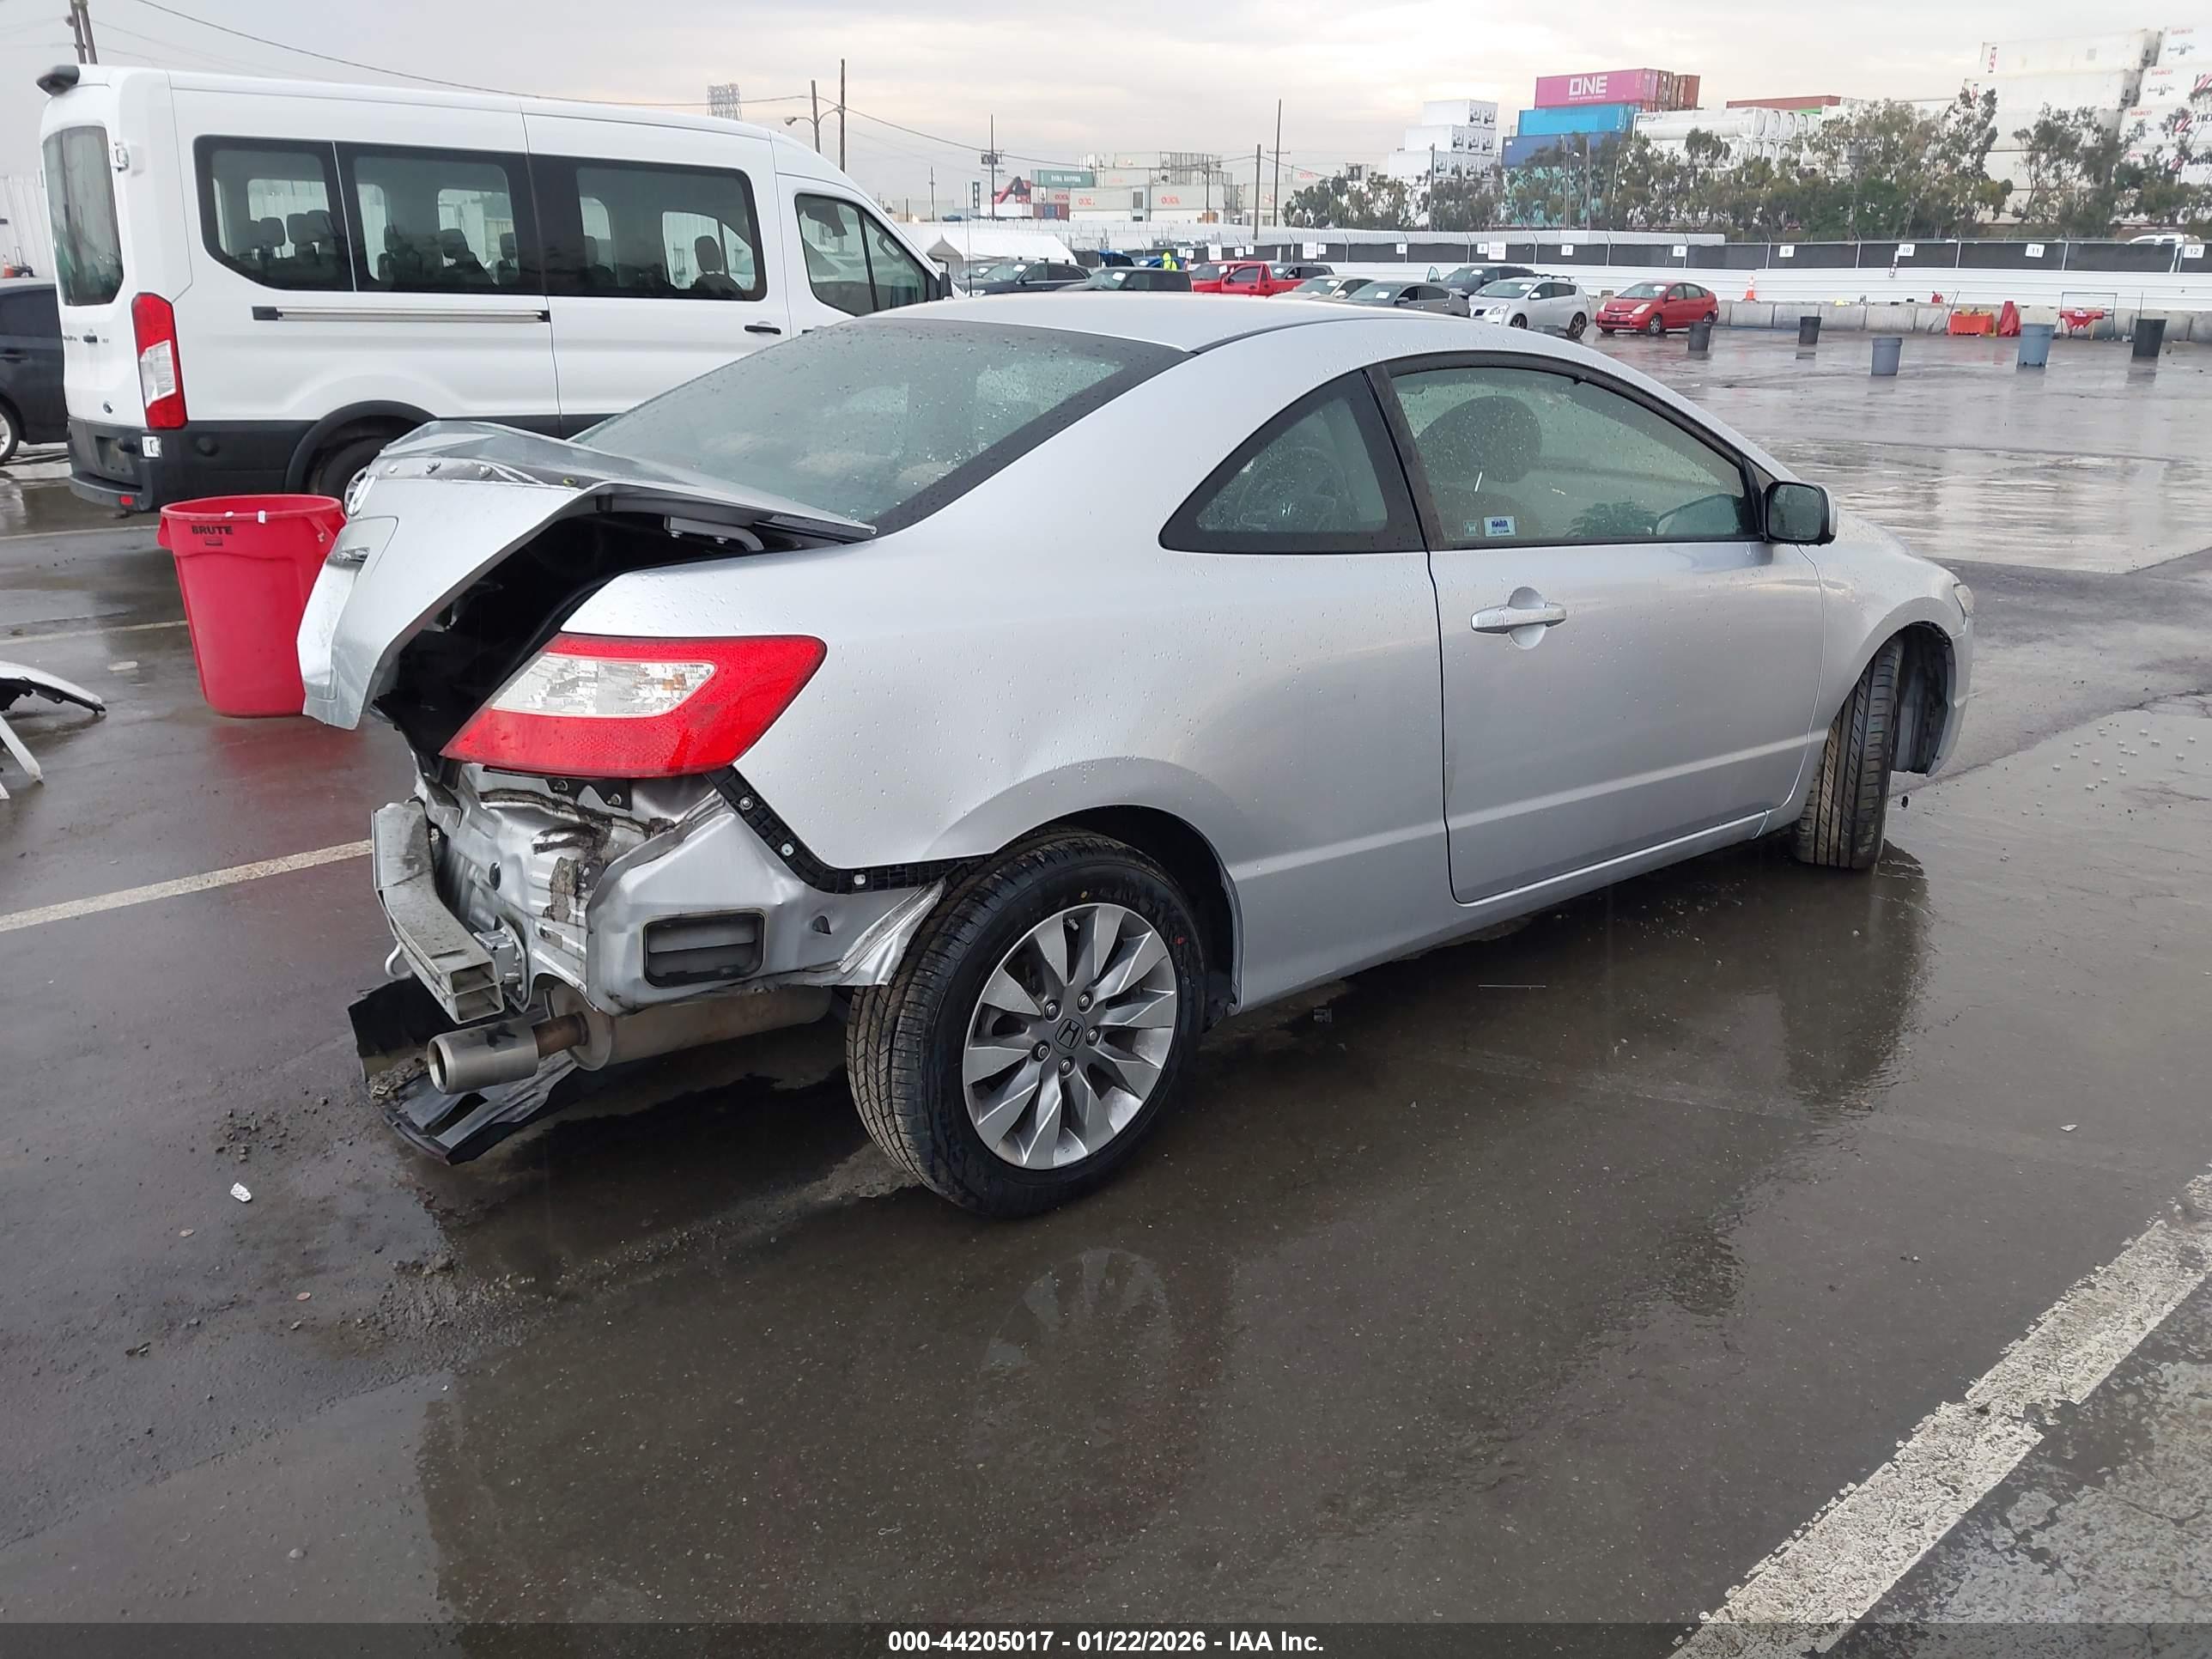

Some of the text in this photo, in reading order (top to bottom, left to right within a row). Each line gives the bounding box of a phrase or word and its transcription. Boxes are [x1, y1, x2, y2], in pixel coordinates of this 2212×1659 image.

[1569, 76, 1608, 96] ONE
[2032, 246, 2039, 255] 11
[192, 525, 234, 535] BRUTE
